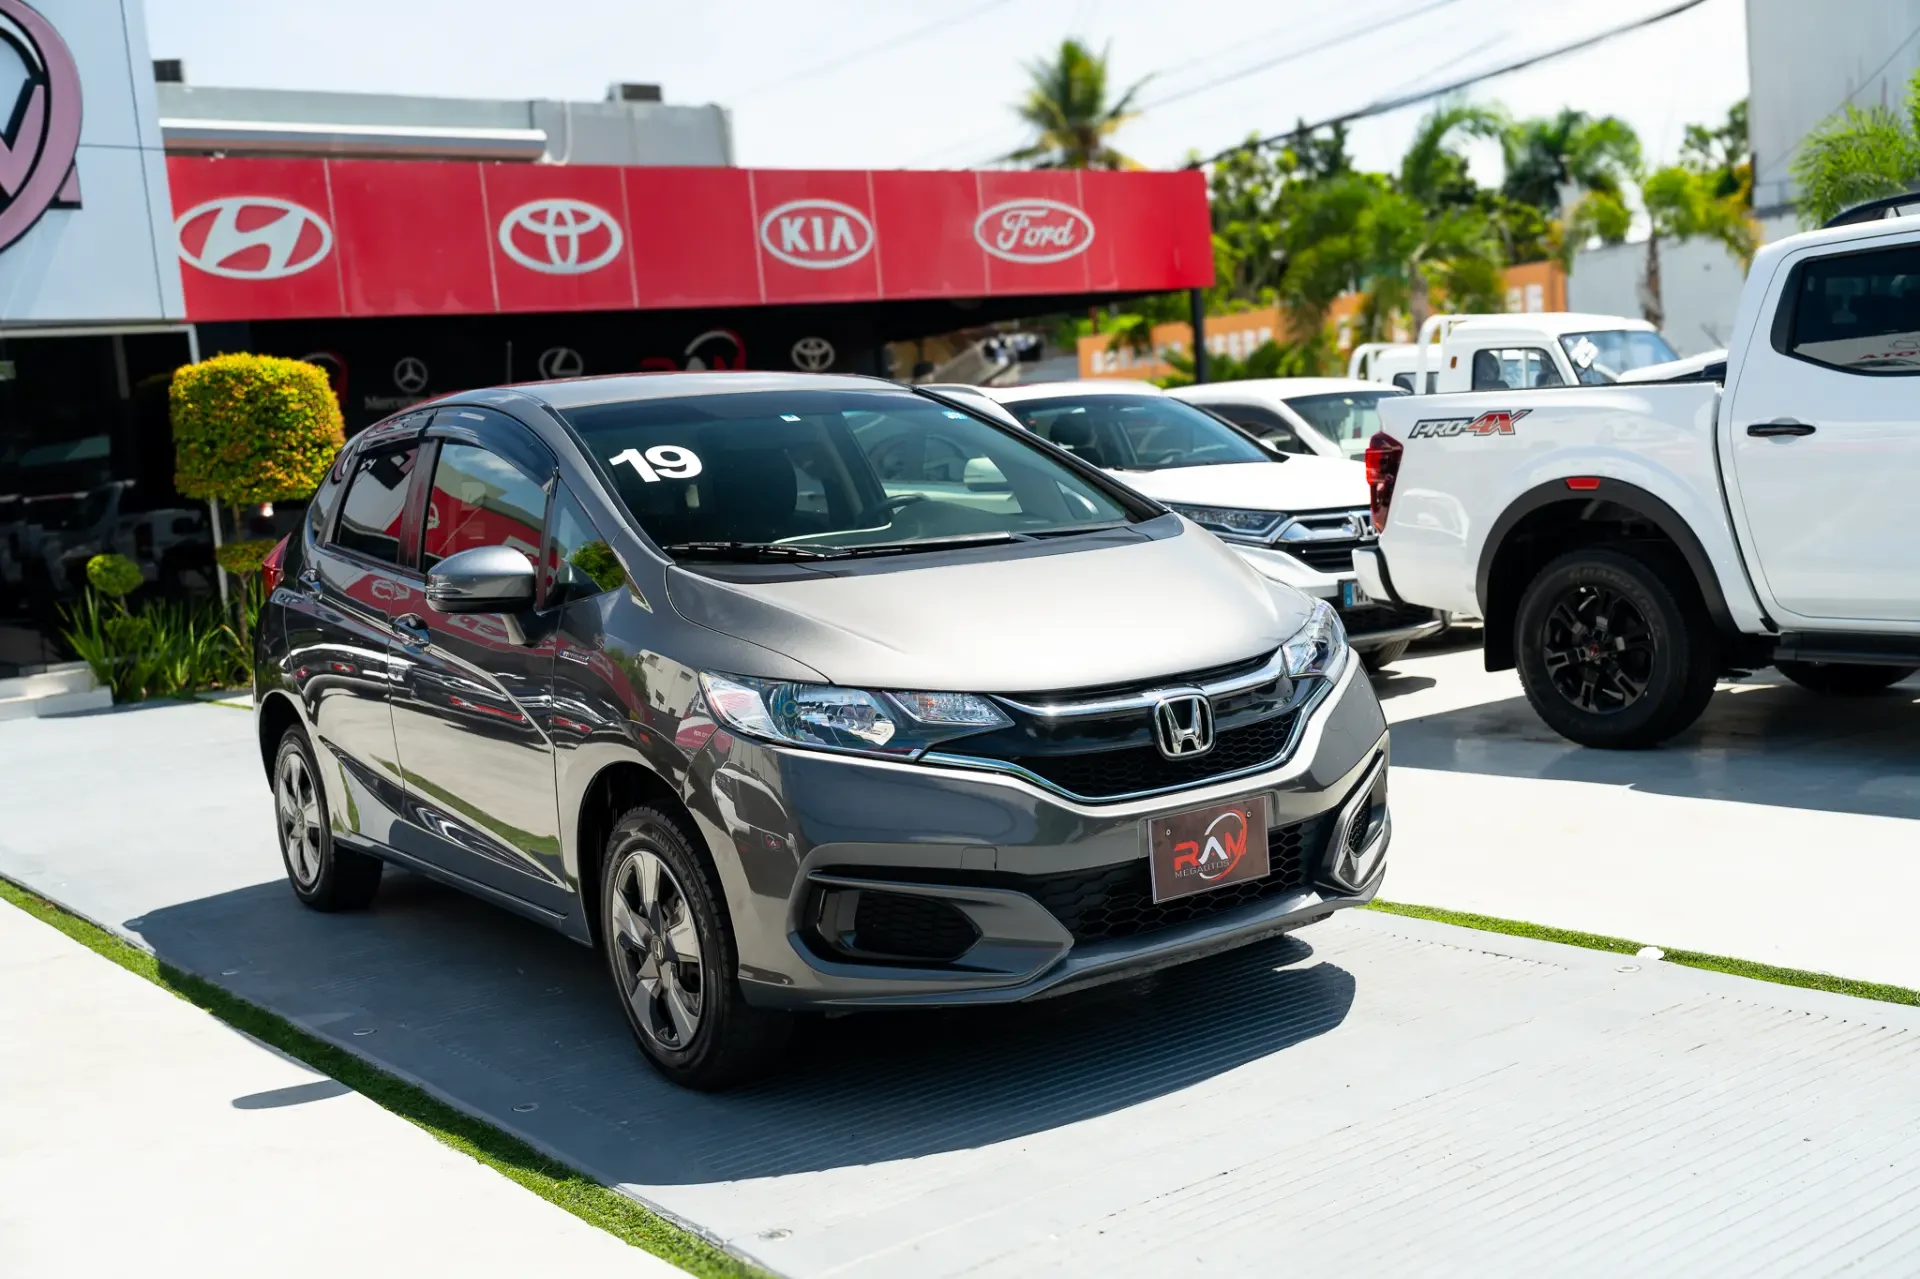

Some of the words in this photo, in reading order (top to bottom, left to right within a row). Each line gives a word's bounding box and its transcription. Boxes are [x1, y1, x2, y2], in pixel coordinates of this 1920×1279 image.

[779, 215, 858, 252] KIA
[996, 208, 1075, 251] Ford
[608, 445, 703, 483] 19
[1174, 831, 1247, 872] RAM
[1174, 859, 1230, 878] MEGAUTOS
